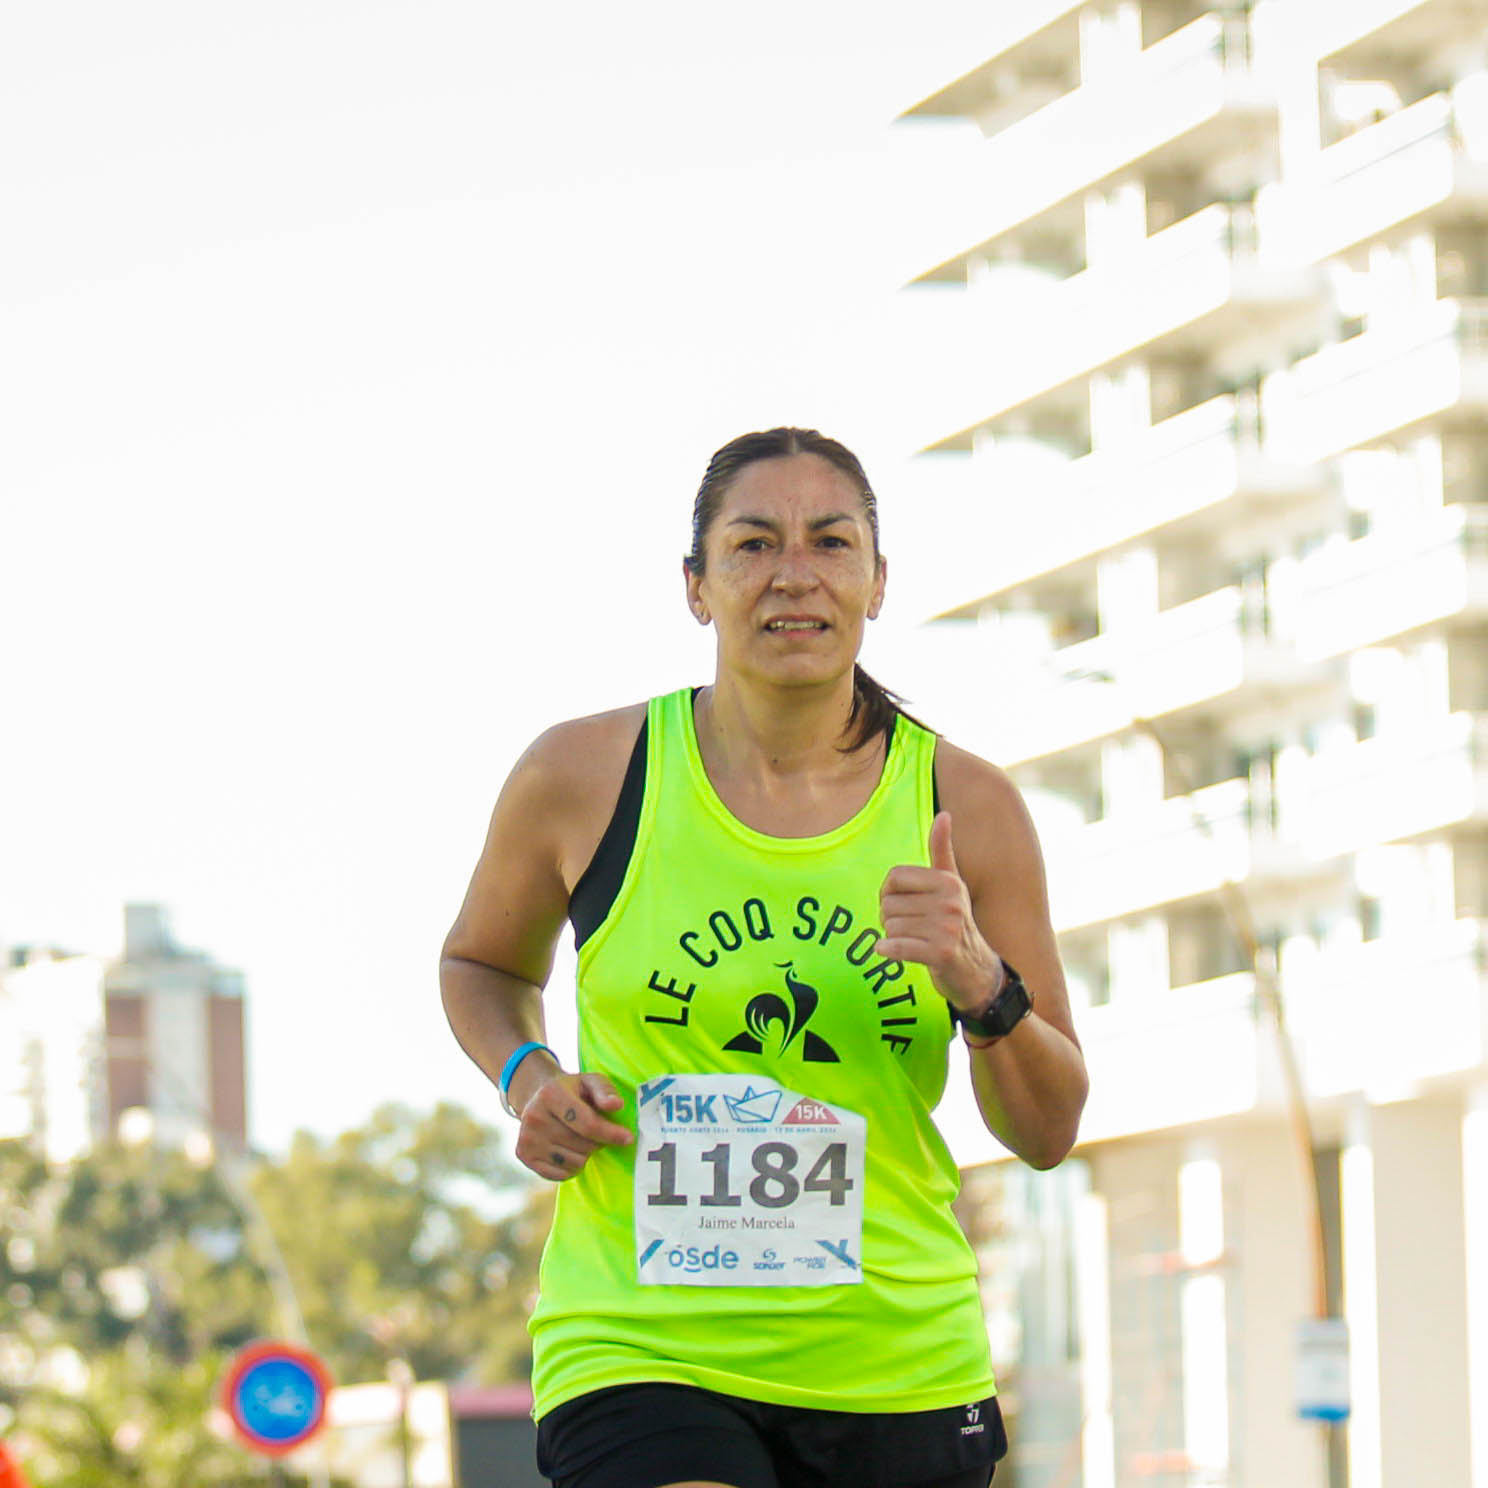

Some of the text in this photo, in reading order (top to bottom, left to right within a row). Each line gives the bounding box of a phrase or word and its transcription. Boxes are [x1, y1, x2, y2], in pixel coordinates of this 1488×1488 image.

[645, 896, 918, 1056] LE COQ SPORTIF
[661, 1094, 718, 1123] 15K
[795, 1103, 829, 1121] 15K
[647, 1141, 854, 1209] 1184
[697, 1215, 796, 1230] Jaime Marcela
